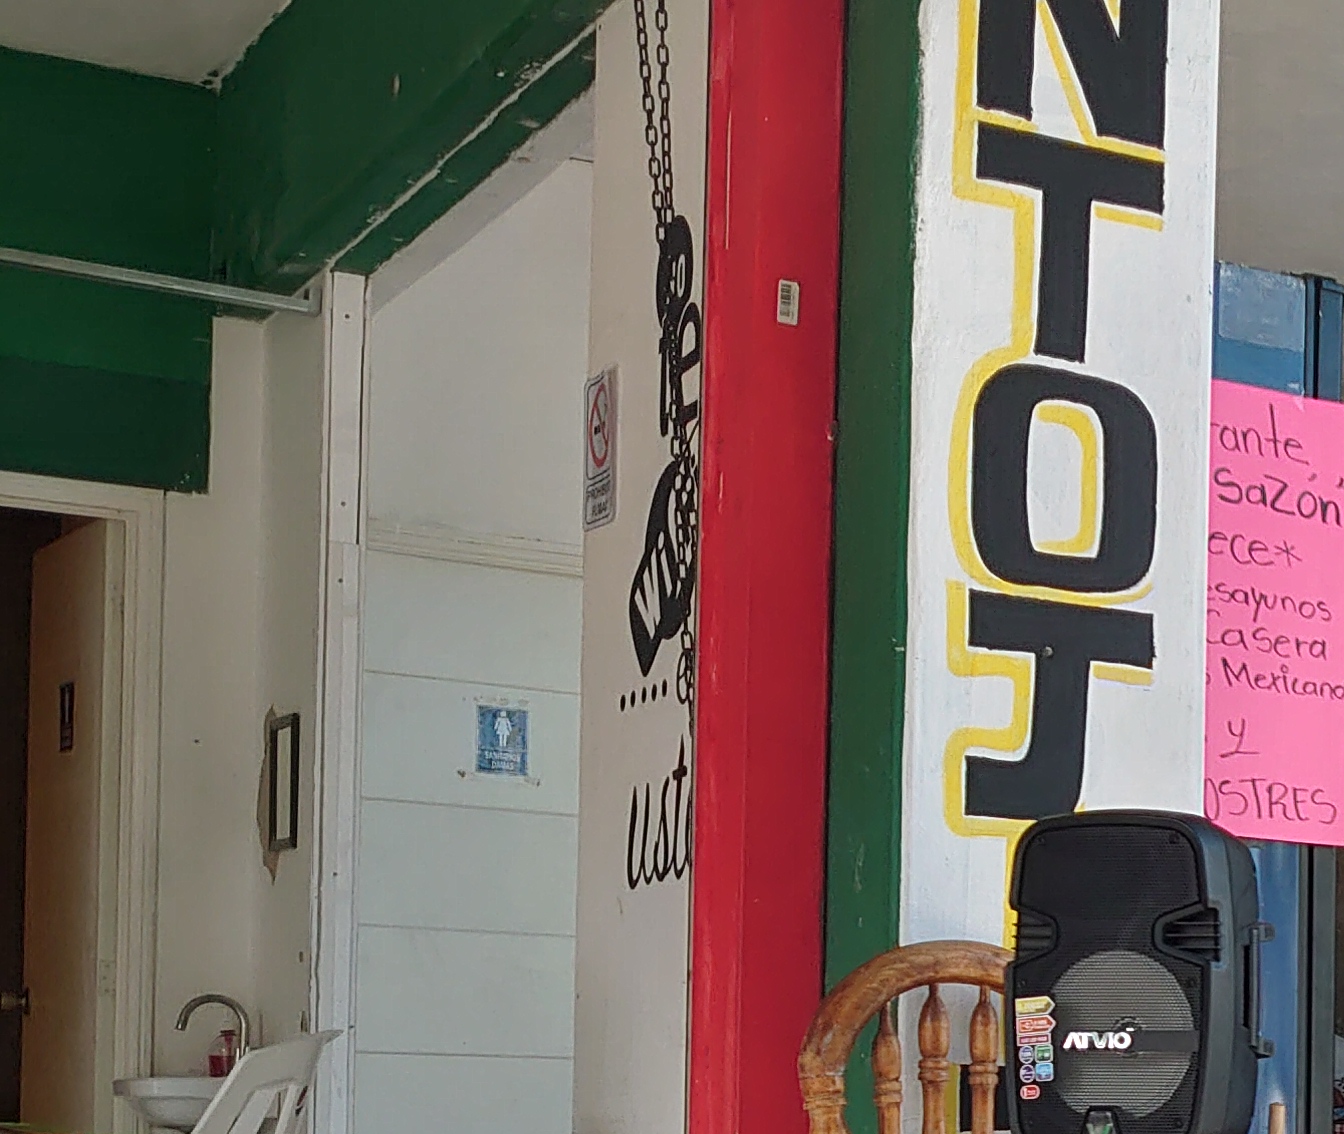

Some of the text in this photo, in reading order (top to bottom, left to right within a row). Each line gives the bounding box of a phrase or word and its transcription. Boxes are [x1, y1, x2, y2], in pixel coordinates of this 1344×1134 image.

[1206, 582, 1332, 623] sayunos
[626, 733, 692, 890] ust
[1063, 1028, 1135, 1051] ATVIO
